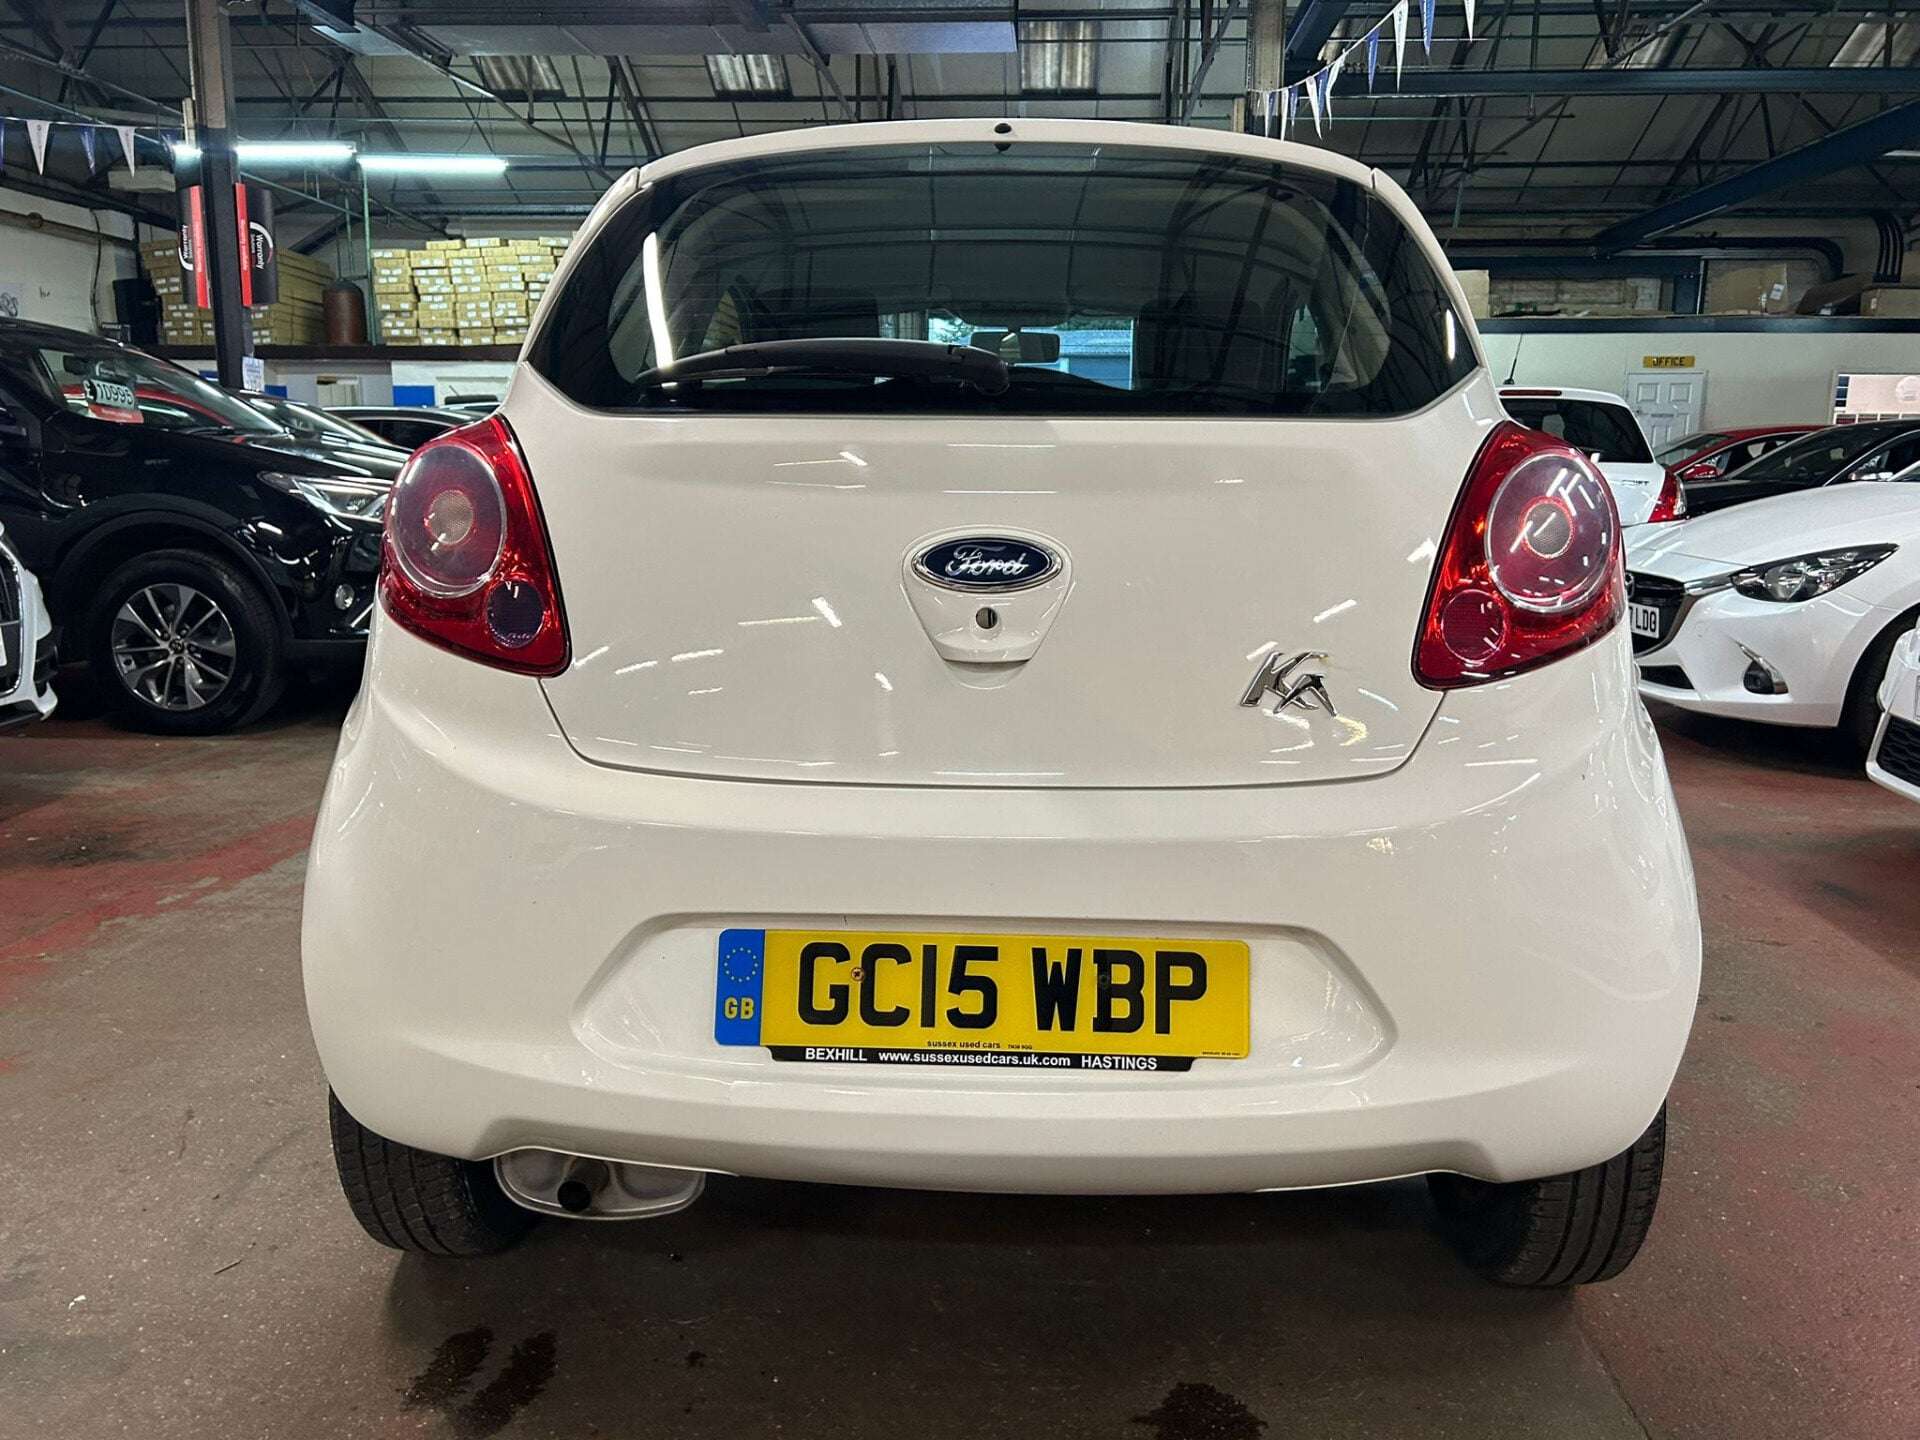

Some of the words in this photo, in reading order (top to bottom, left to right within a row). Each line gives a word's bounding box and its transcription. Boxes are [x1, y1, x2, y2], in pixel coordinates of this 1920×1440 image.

[256, 233, 264, 269] Warranty
[1652, 356, 1685, 367] OFFICE
[944, 544, 1029, 576] Ford
[798, 942, 998, 1029] GC15
[1032, 947, 1207, 1035] WBP
[724, 997, 754, 1019] GB
[927, 1040, 957, 1048] sussex
[960, 1041, 981, 1049] used
[805, 1047, 867, 1062] BEXHILL
[878, 1051, 1071, 1067] www.sussexusedcars.uk.com
[1081, 1055, 1158, 1070] HASTINGS
